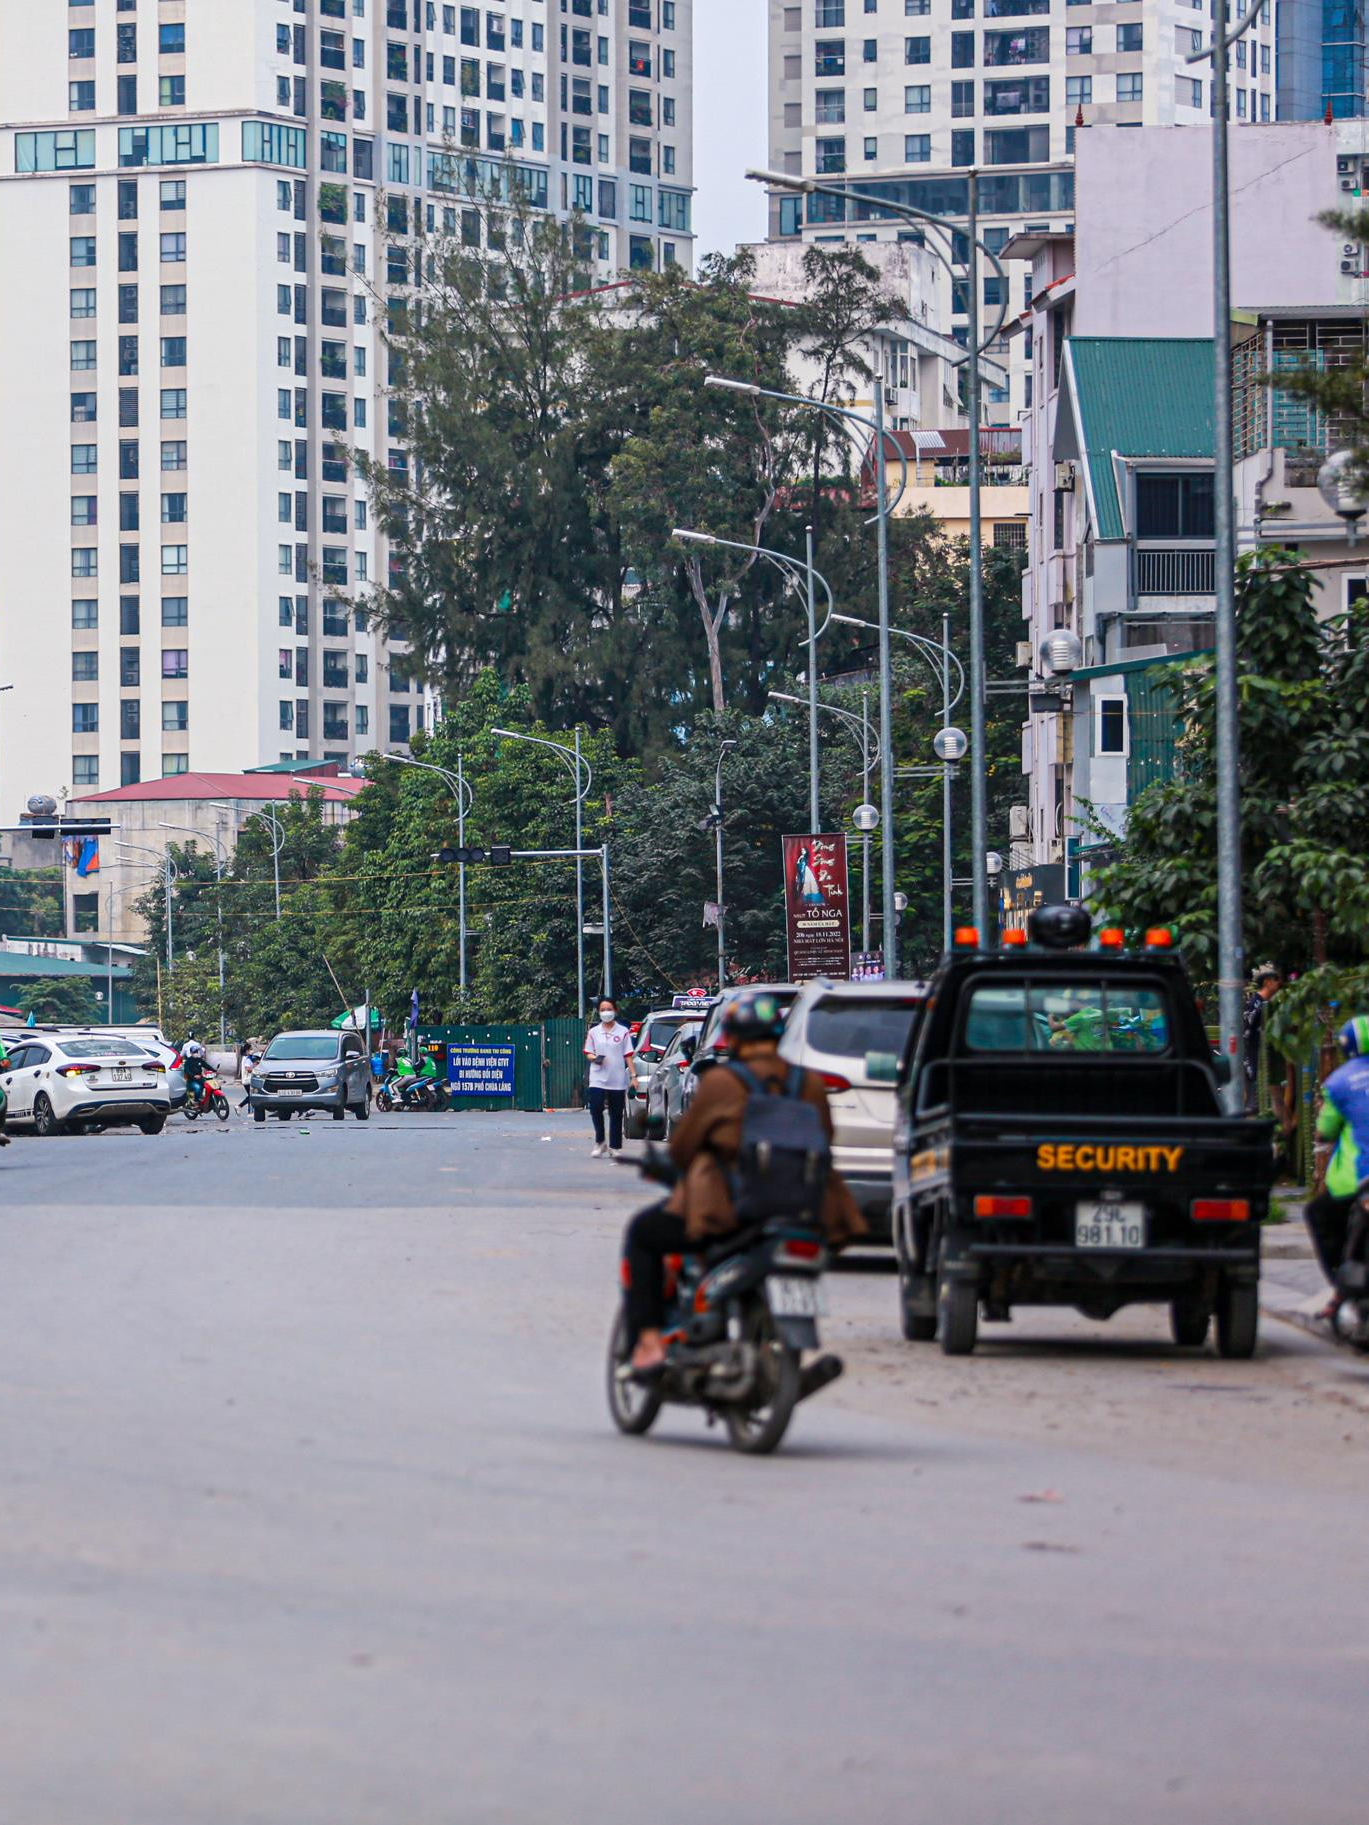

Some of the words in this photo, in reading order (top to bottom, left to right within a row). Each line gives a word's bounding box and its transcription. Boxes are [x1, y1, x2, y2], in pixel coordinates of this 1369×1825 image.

[807, 906, 820, 918] TỐ
[821, 909, 843, 918] NGA
[1036, 1143, 1184, 1172] SECURITY
